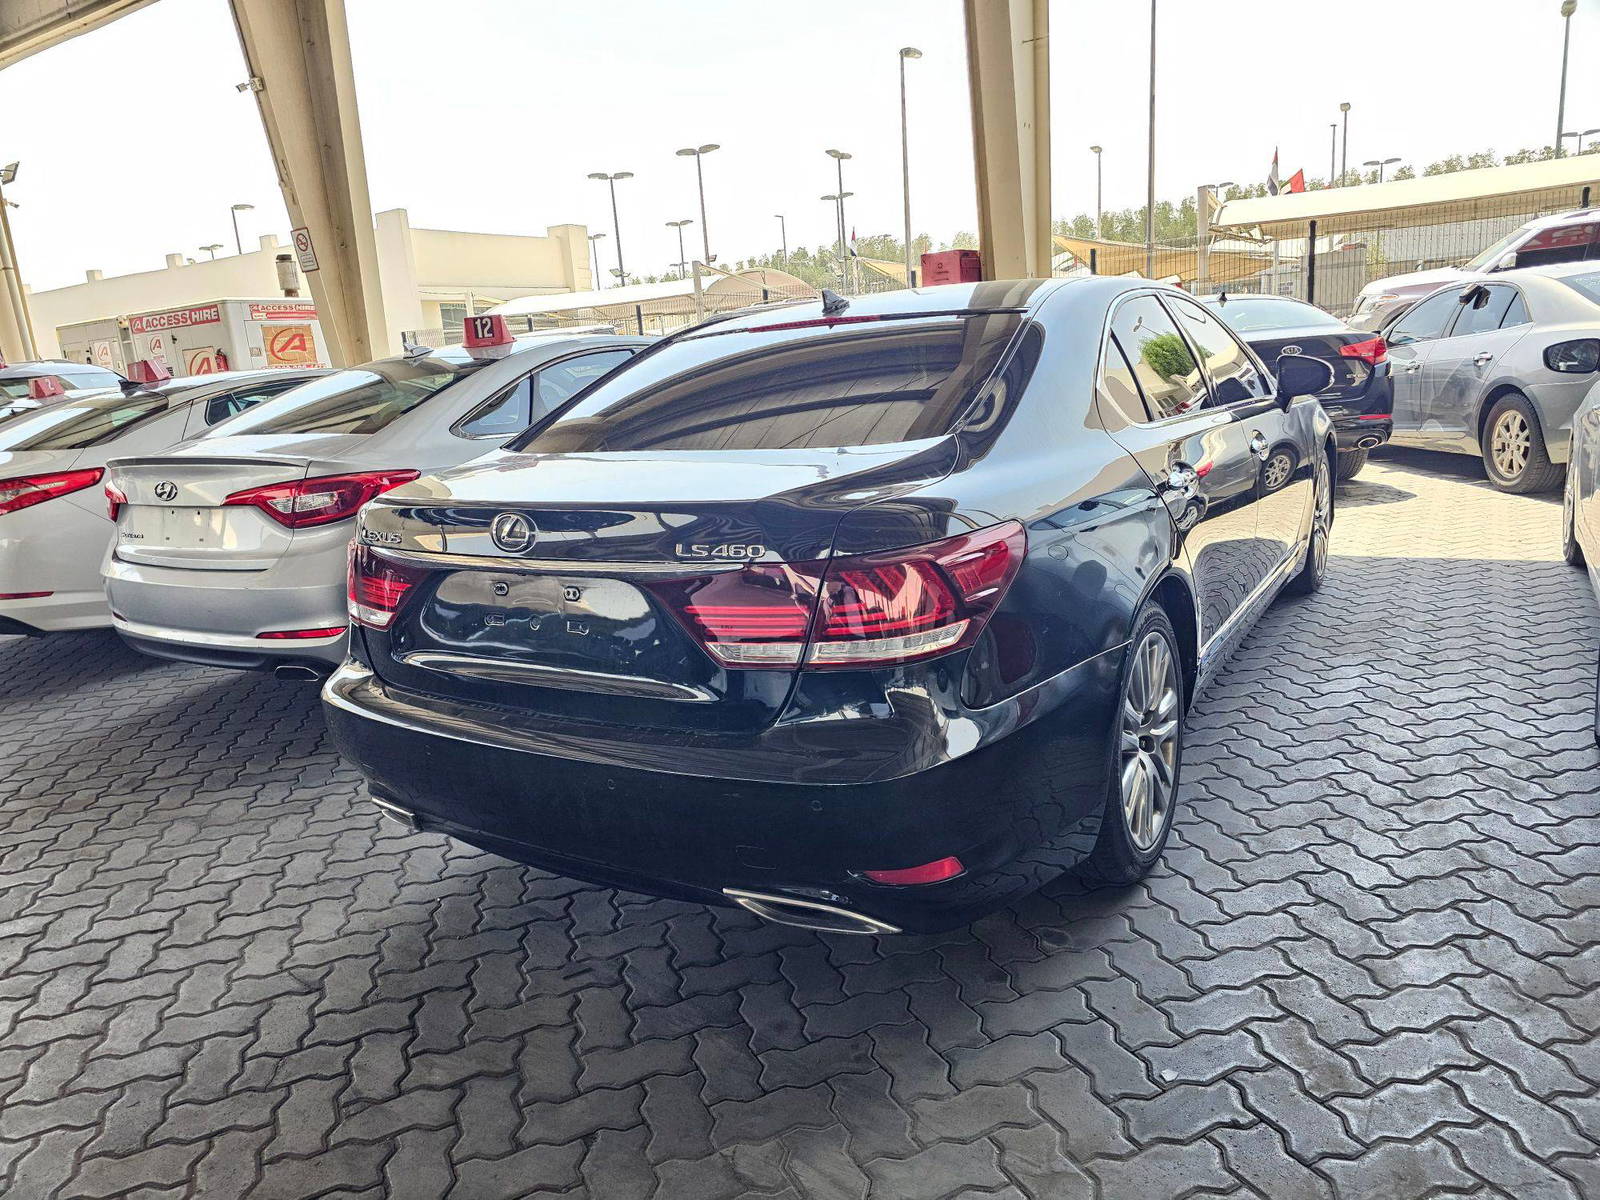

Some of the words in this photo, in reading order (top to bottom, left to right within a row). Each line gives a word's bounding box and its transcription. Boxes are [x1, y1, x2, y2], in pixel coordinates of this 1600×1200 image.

[145, 313, 188, 330] ACCESS
[191, 308, 219, 323] HIRE
[474, 317, 493, 338] 12
[362, 529, 402, 543] LEXUS
